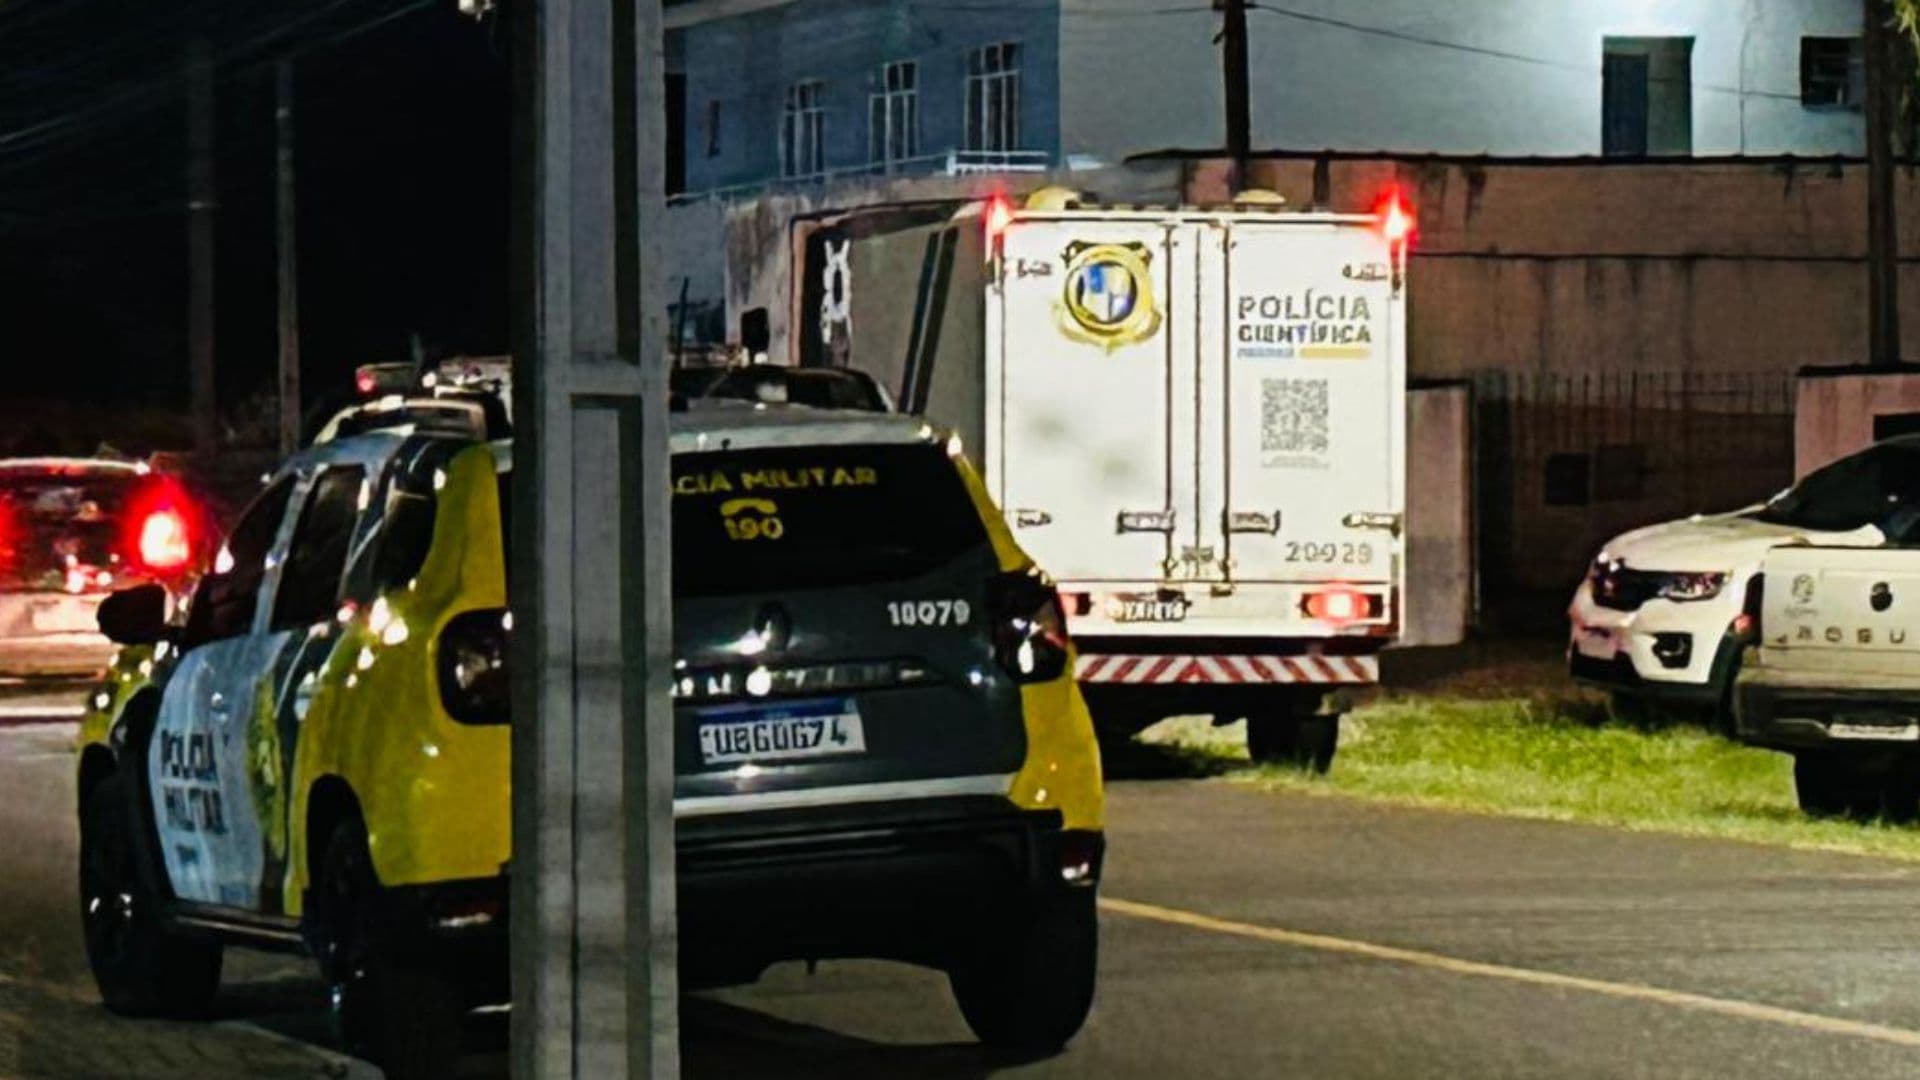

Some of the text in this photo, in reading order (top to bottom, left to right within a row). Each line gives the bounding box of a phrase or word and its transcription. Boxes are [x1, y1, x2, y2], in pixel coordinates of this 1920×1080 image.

[1238, 287, 1371, 320] POLÍCIA
[741, 466, 877, 490] MILITAR
[724, 517, 784, 540] 190
